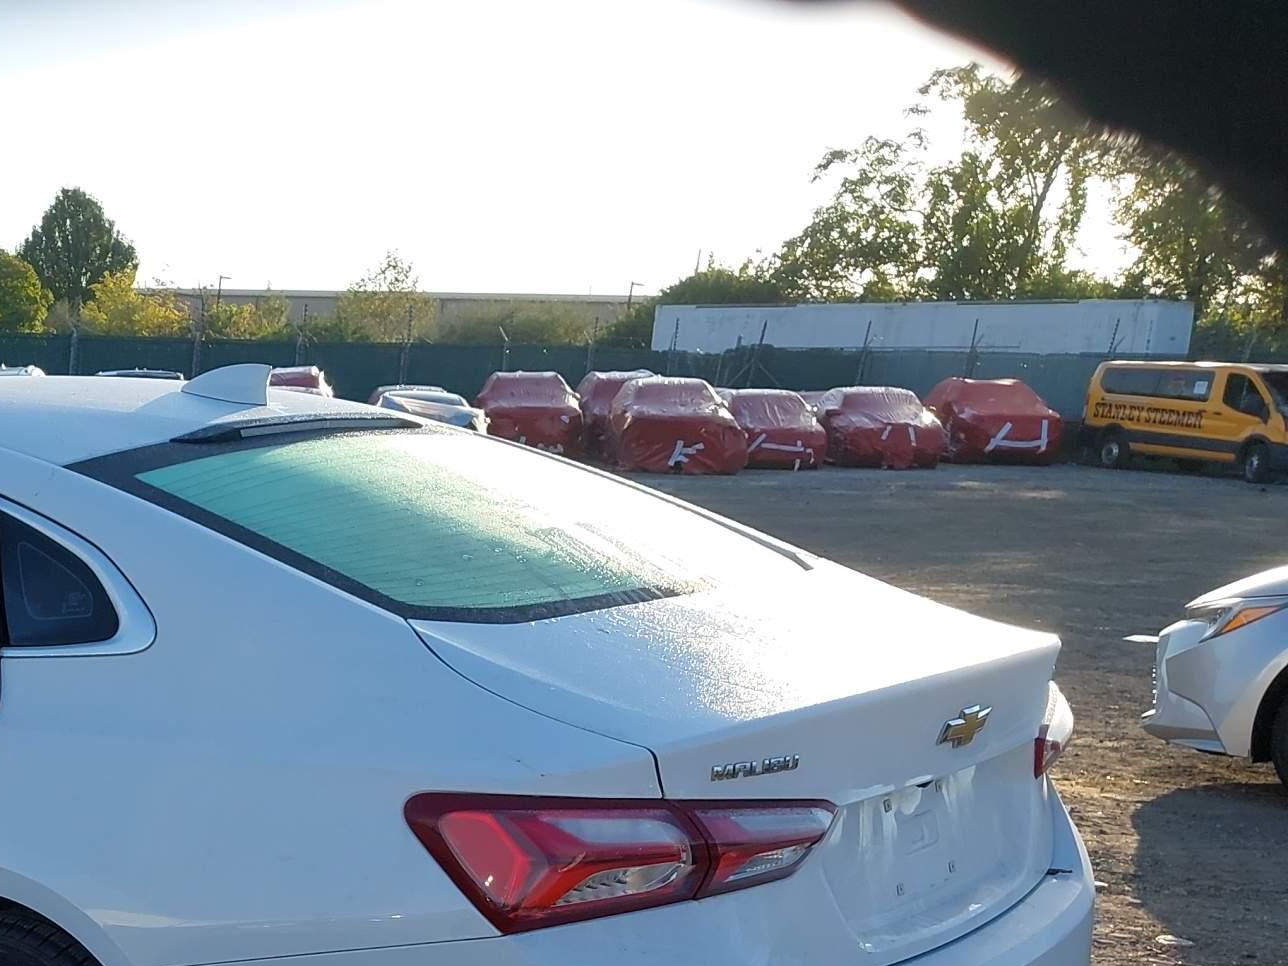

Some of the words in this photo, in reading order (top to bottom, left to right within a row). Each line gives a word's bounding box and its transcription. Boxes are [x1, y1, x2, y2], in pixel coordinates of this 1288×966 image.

[1093, 402, 1144, 422] STANLEY
[1145, 407, 1206, 429] STEEMER
[711, 753, 800, 782] MALIBU
